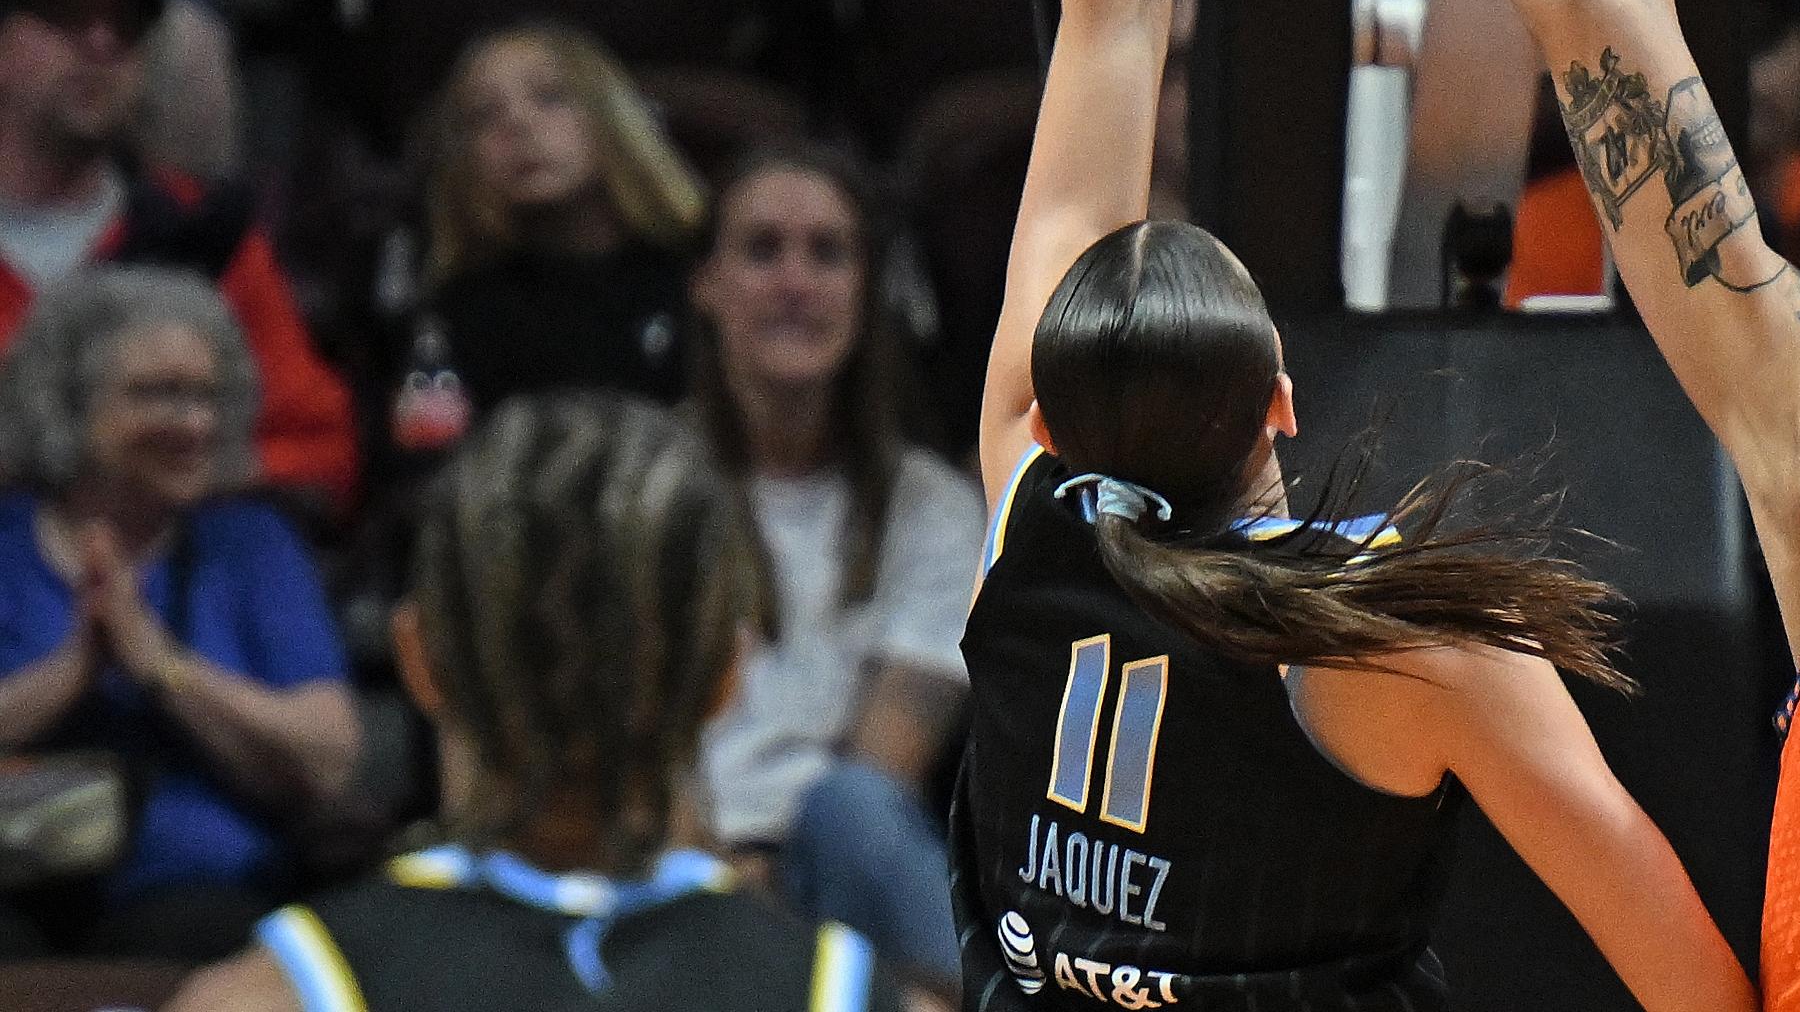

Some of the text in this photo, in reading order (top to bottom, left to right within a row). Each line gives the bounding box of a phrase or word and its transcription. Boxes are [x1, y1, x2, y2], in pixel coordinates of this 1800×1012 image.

[1046, 633, 1169, 834] 11
[1019, 813, 1172, 931] JAQUEZ
[1054, 951, 1178, 1011] AT&T
